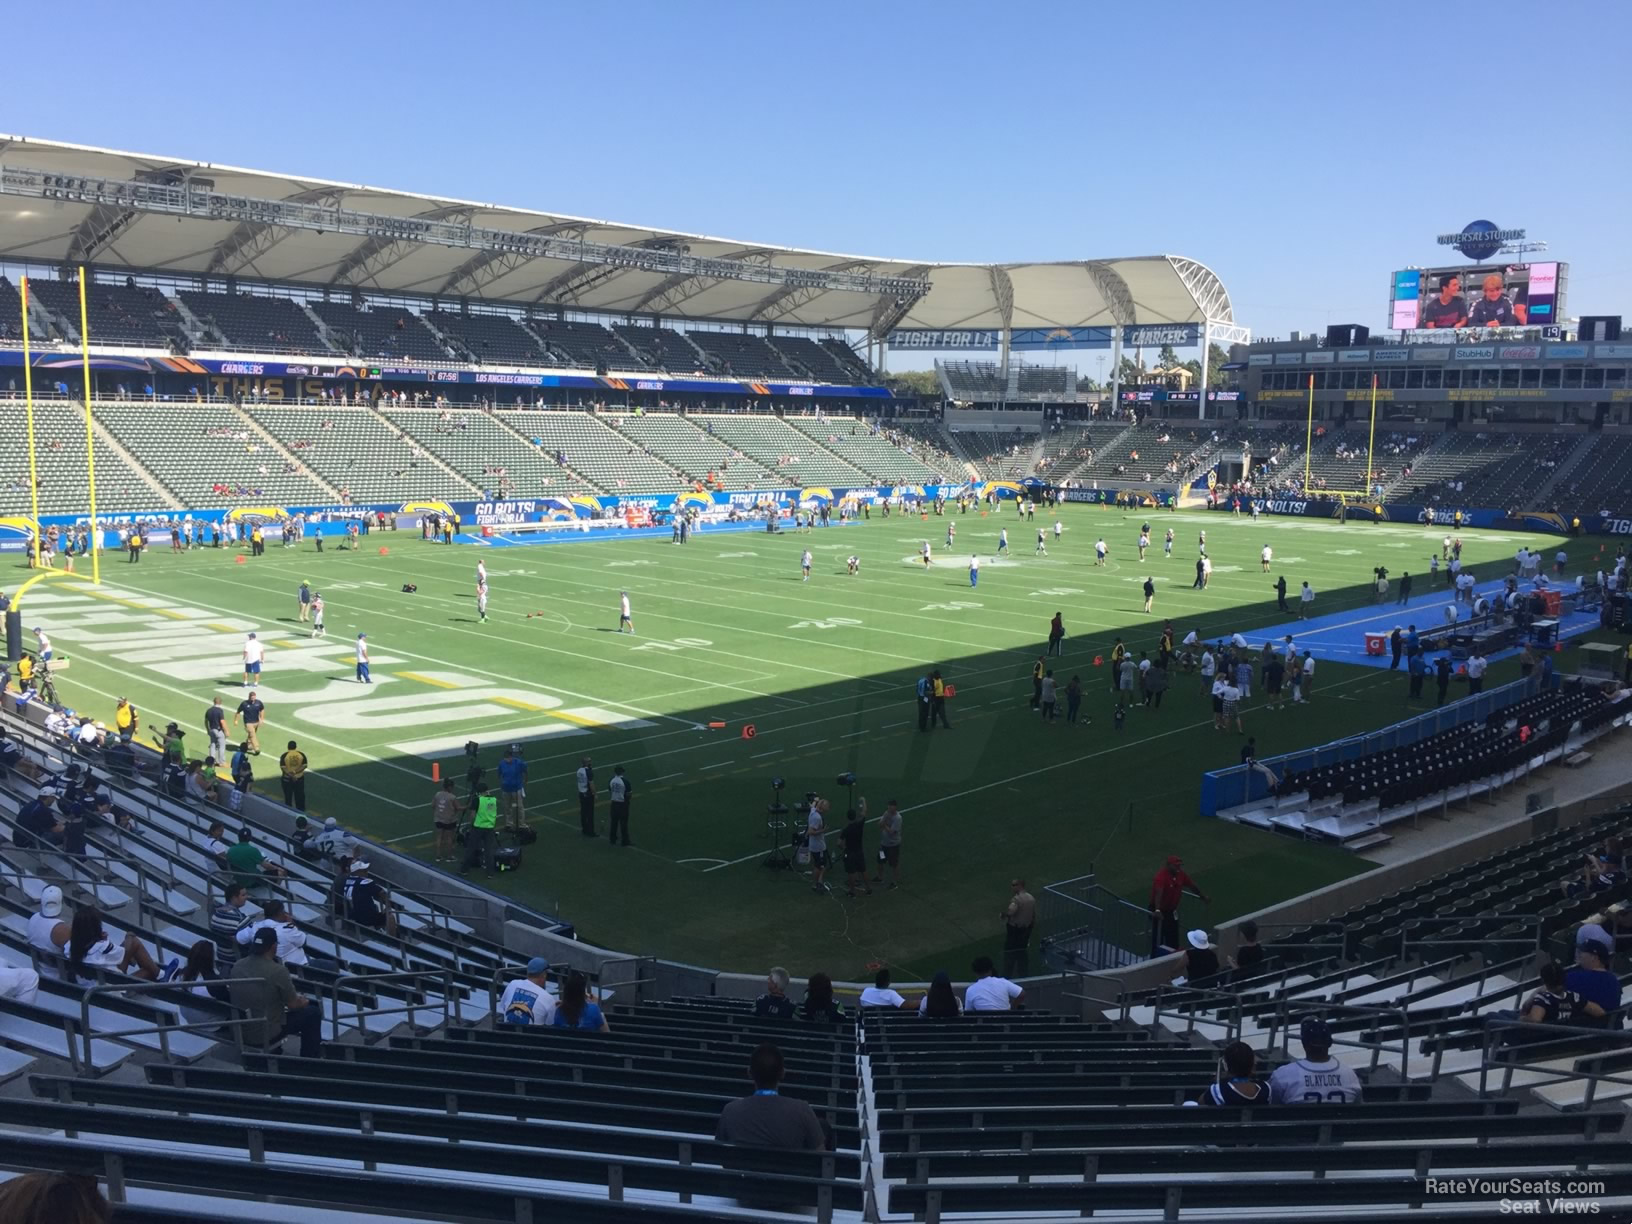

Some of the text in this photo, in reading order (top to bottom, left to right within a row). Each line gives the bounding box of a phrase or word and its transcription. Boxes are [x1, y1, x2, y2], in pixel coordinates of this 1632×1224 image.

[1437, 229, 1526, 245] UNIVERSAL STUDIOS
[1453, 242, 1508, 251] HOLLYWOOD
[894, 331, 992, 347] FIGHT FOR LA
[1131, 329, 1189, 345] CHARGERS
[1457, 350, 1492, 358] StubHub
[221, 363, 264, 375] CHARGERS
[312, 366, 367, 378] 0 0
[437, 372, 457, 381] 67:56
[476, 373, 543, 385] LOS ANGELES CHARGERS
[211, 377, 285, 399] THIS
[637, 381, 664, 390] CHARGERS
[789, 387, 814, 396] CHARGERS
[475, 503, 493, 515] GO
[477, 514, 499, 525] FIGHT
[516, 513, 525, 522] LA
[320, 840, 336, 856] 12
[1304, 1074, 1342, 1088] BLAYLOCK
